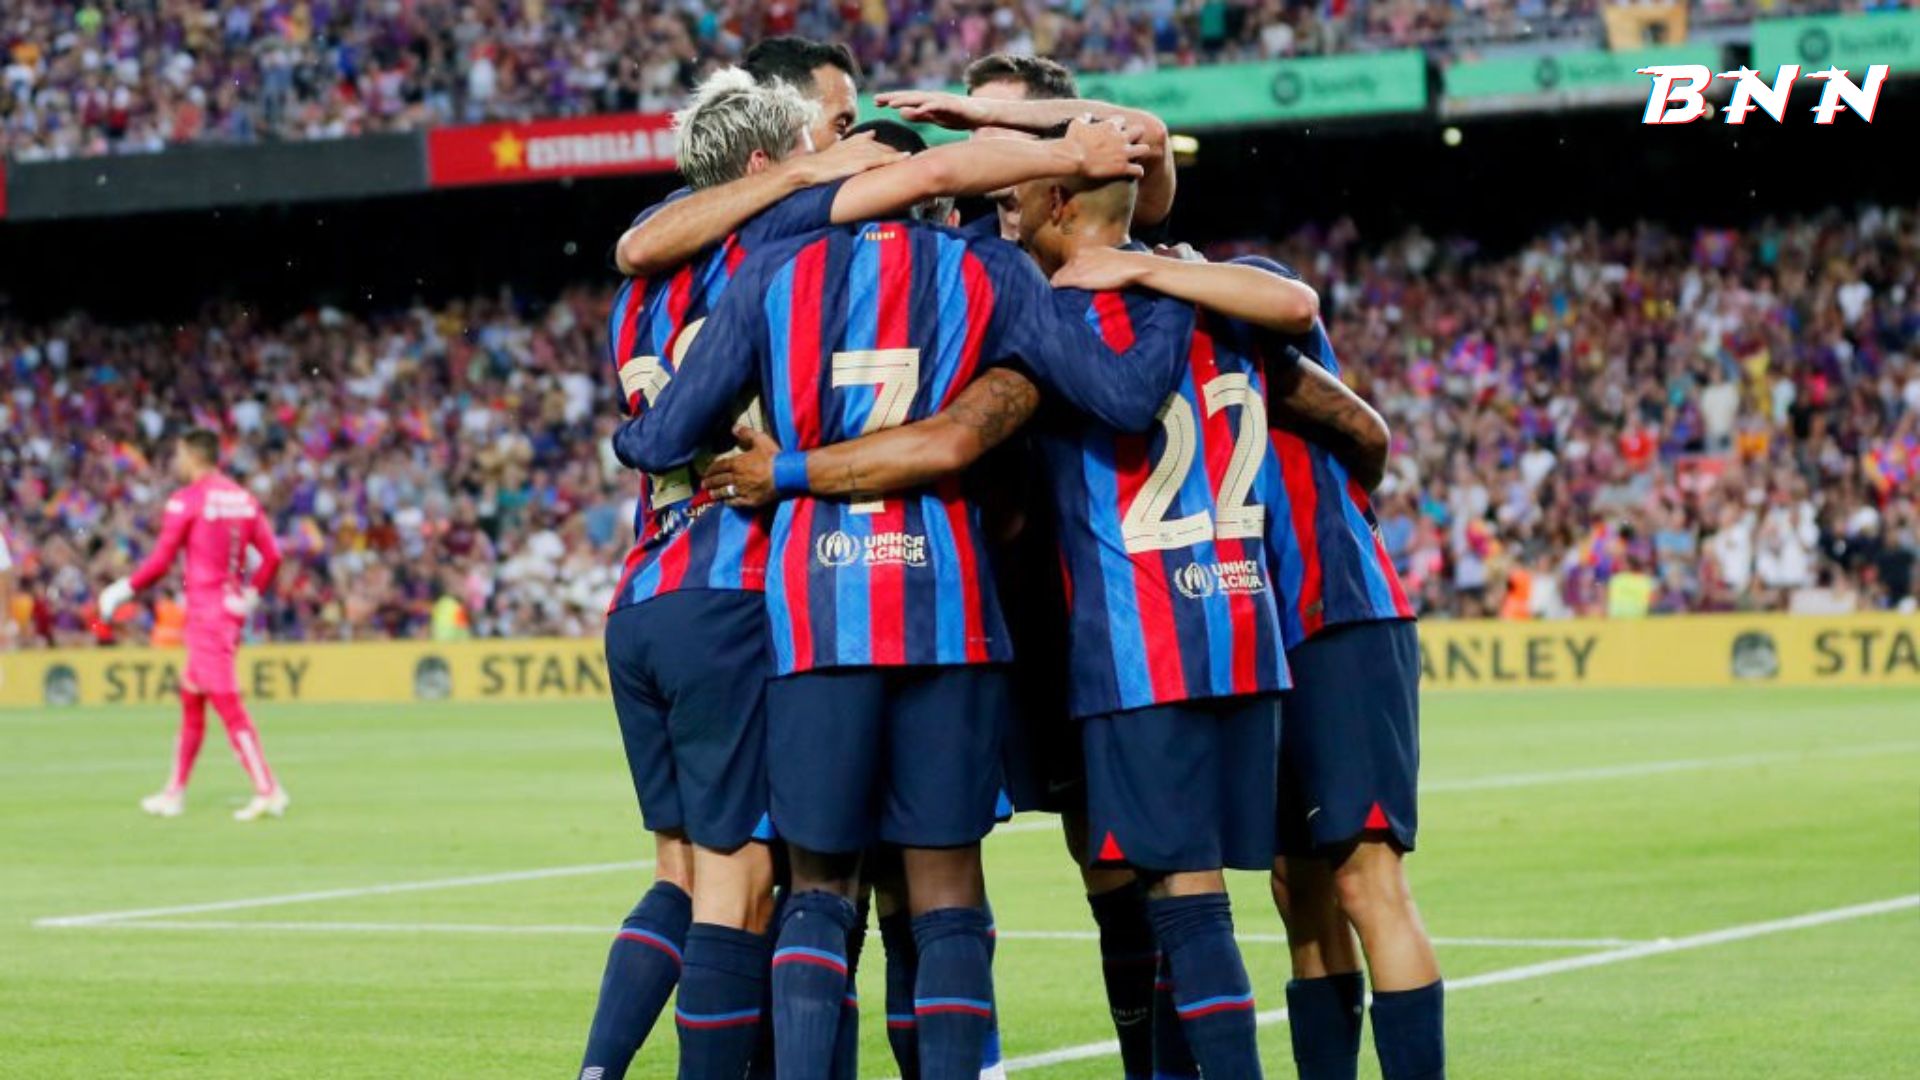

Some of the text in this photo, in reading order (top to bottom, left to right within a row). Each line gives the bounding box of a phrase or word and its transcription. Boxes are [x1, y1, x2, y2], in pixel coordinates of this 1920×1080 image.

[832, 348, 920, 513] 7
[1121, 373, 1268, 554] 22
[863, 547, 925, 561] ACNUR
[864, 532, 925, 549] UNHCR
